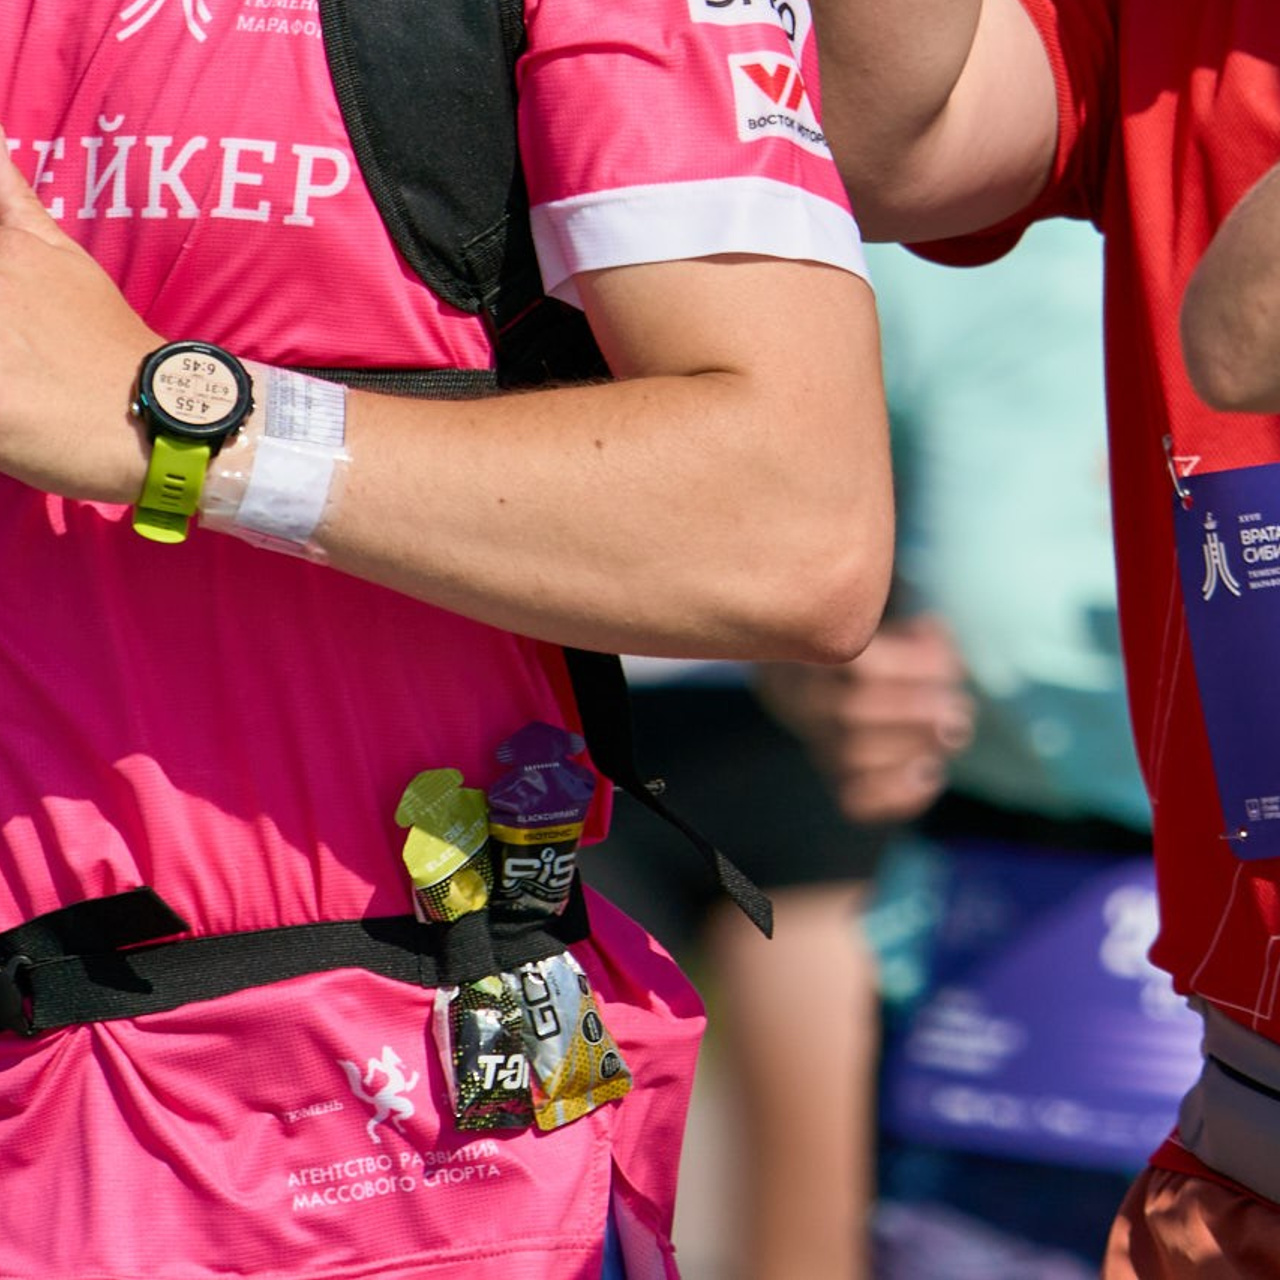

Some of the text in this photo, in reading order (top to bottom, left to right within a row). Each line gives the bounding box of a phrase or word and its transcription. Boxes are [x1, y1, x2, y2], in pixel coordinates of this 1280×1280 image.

[6, 114, 351, 226] ЕЙКЕР
[287, 1154, 393, 1188] АГЕНТСТВО
[293, 1164, 500, 1212] МАССОВОГО СПОРТА
